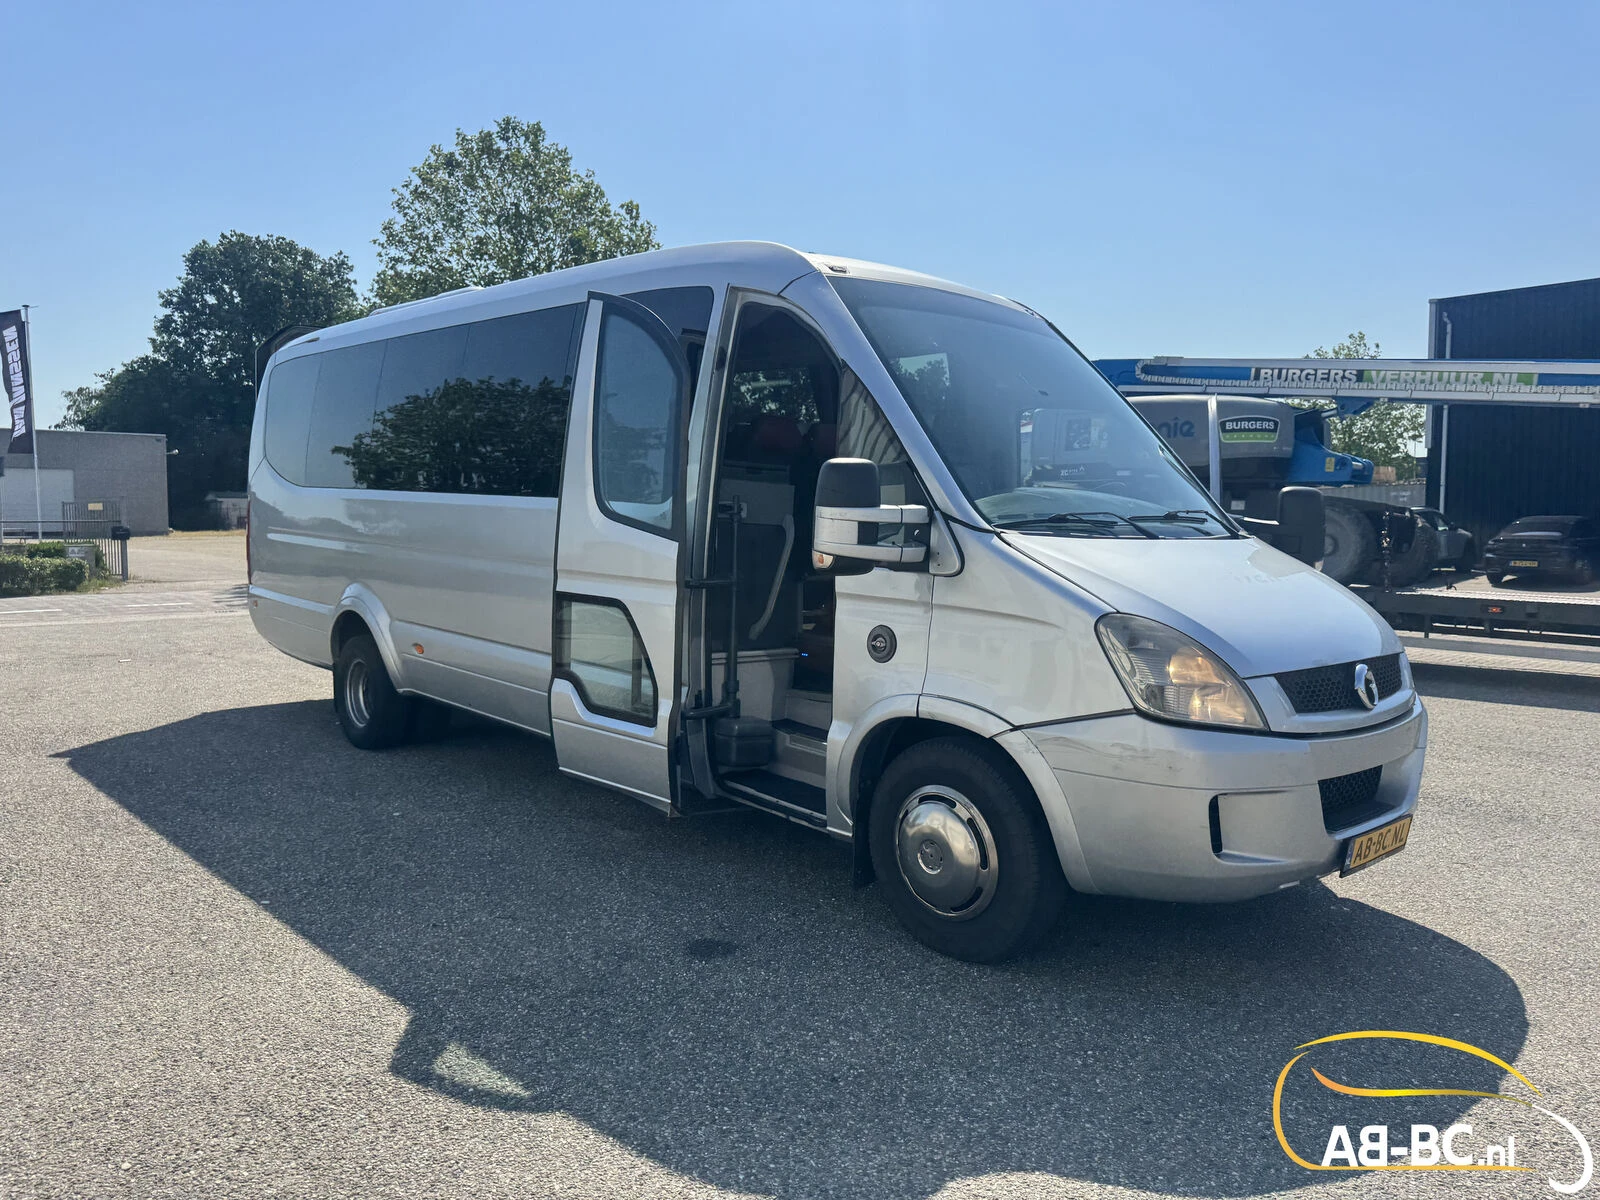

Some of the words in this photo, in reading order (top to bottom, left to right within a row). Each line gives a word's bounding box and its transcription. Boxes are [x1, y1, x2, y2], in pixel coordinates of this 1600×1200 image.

[1259, 368, 1358, 383] BURGERS
[1157, 416, 1195, 438] nie
[1225, 421, 1275, 430] BURGERS
